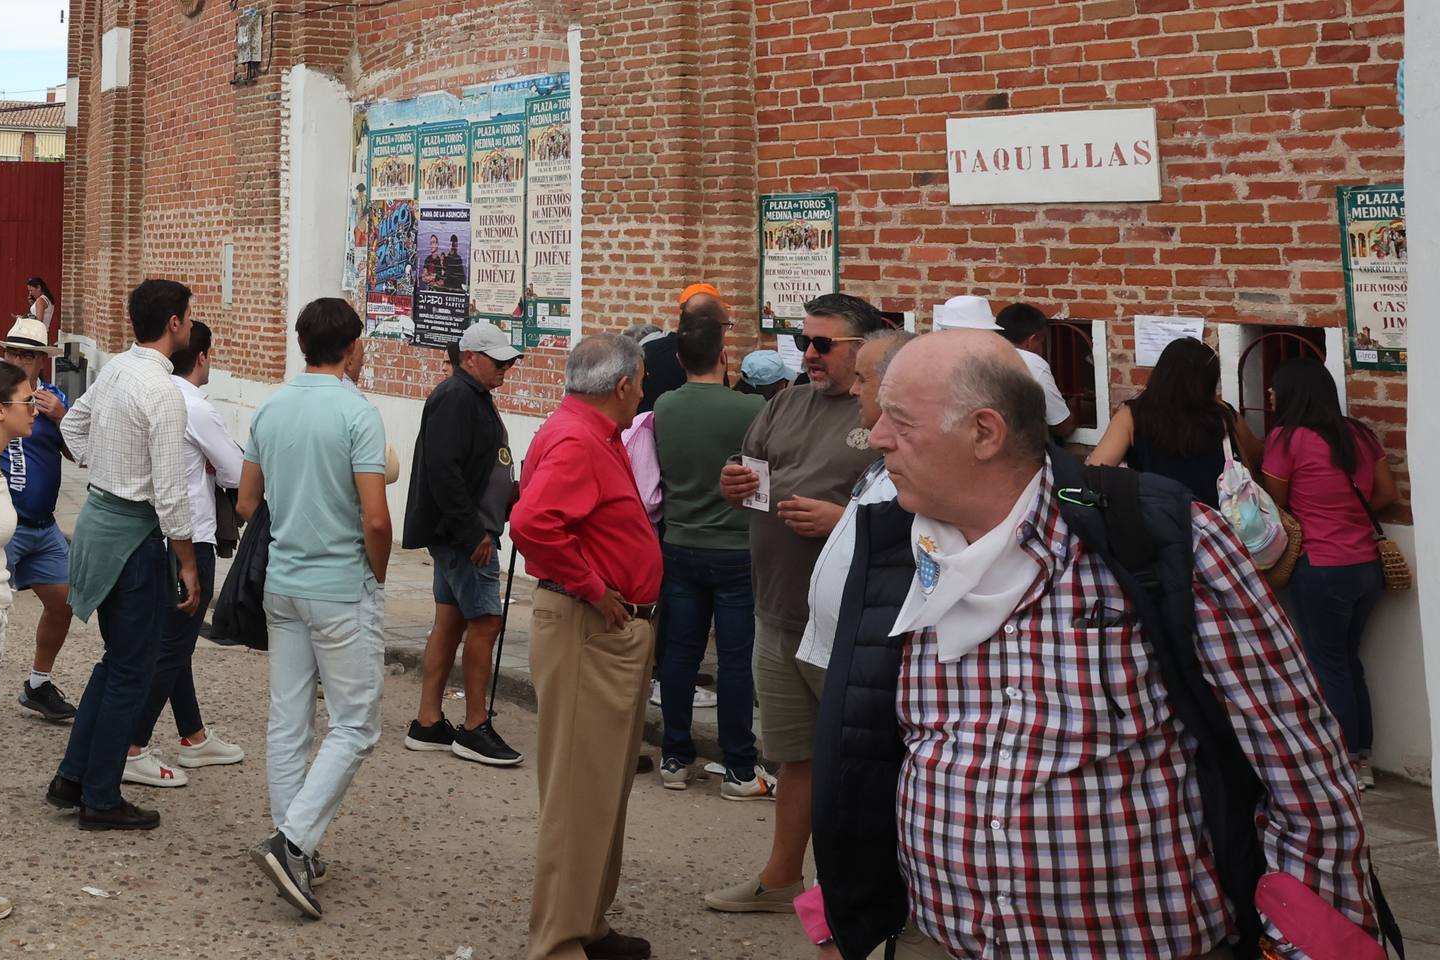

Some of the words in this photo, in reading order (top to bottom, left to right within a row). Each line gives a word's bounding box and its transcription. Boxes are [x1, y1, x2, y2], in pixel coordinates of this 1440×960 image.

[533, 101, 552, 114] PLAZA
[529, 113, 551, 126] MEDINA
[477, 125, 496, 138] PLAZA
[500, 123, 520, 135] TOROS
[375, 133, 391, 145] PLAZA
[394, 132, 412, 144] TOROS
[424, 134, 441, 146] PLAZA
[444, 132, 463, 144] TOROS
[474, 138, 494, 149] MEDINA
[502, 134, 523, 147] CAMPO
[373, 145, 390, 156] MEDINA
[396, 143, 414, 154] CAMPO
[421, 146, 440, 157] MEDINA
[446, 144, 466, 155] CAMPO
[949, 139, 1153, 174] TAQUILLAS
[536, 192, 571, 206] HERMOS
[769, 200, 792, 210] PLAZA
[799, 199, 826, 210] TOROS
[1356, 192, 1399, 205] PLAZA
[446, 209, 467, 218] ASUNCIÓN
[532, 210, 539, 219] DE
[766, 210, 792, 220] MEDINA
[802, 209, 831, 220] CAMPO
[1351, 205, 1398, 219] MEDINA
[479, 214, 515, 227] HERMOSO
[476, 230, 482, 238] DE
[484, 226, 519, 239] MENDOZA
[473, 249, 520, 264] CASTELLA
[773, 281, 821, 292] CASTELLA
[1356, 283, 1407, 293] HERMOSO
[1373, 300, 1407, 313] CAS
[1382, 316, 1407, 330] JIM
[11, 452, 24, 473] MEDIO
[9, 476, 27, 492] 40
